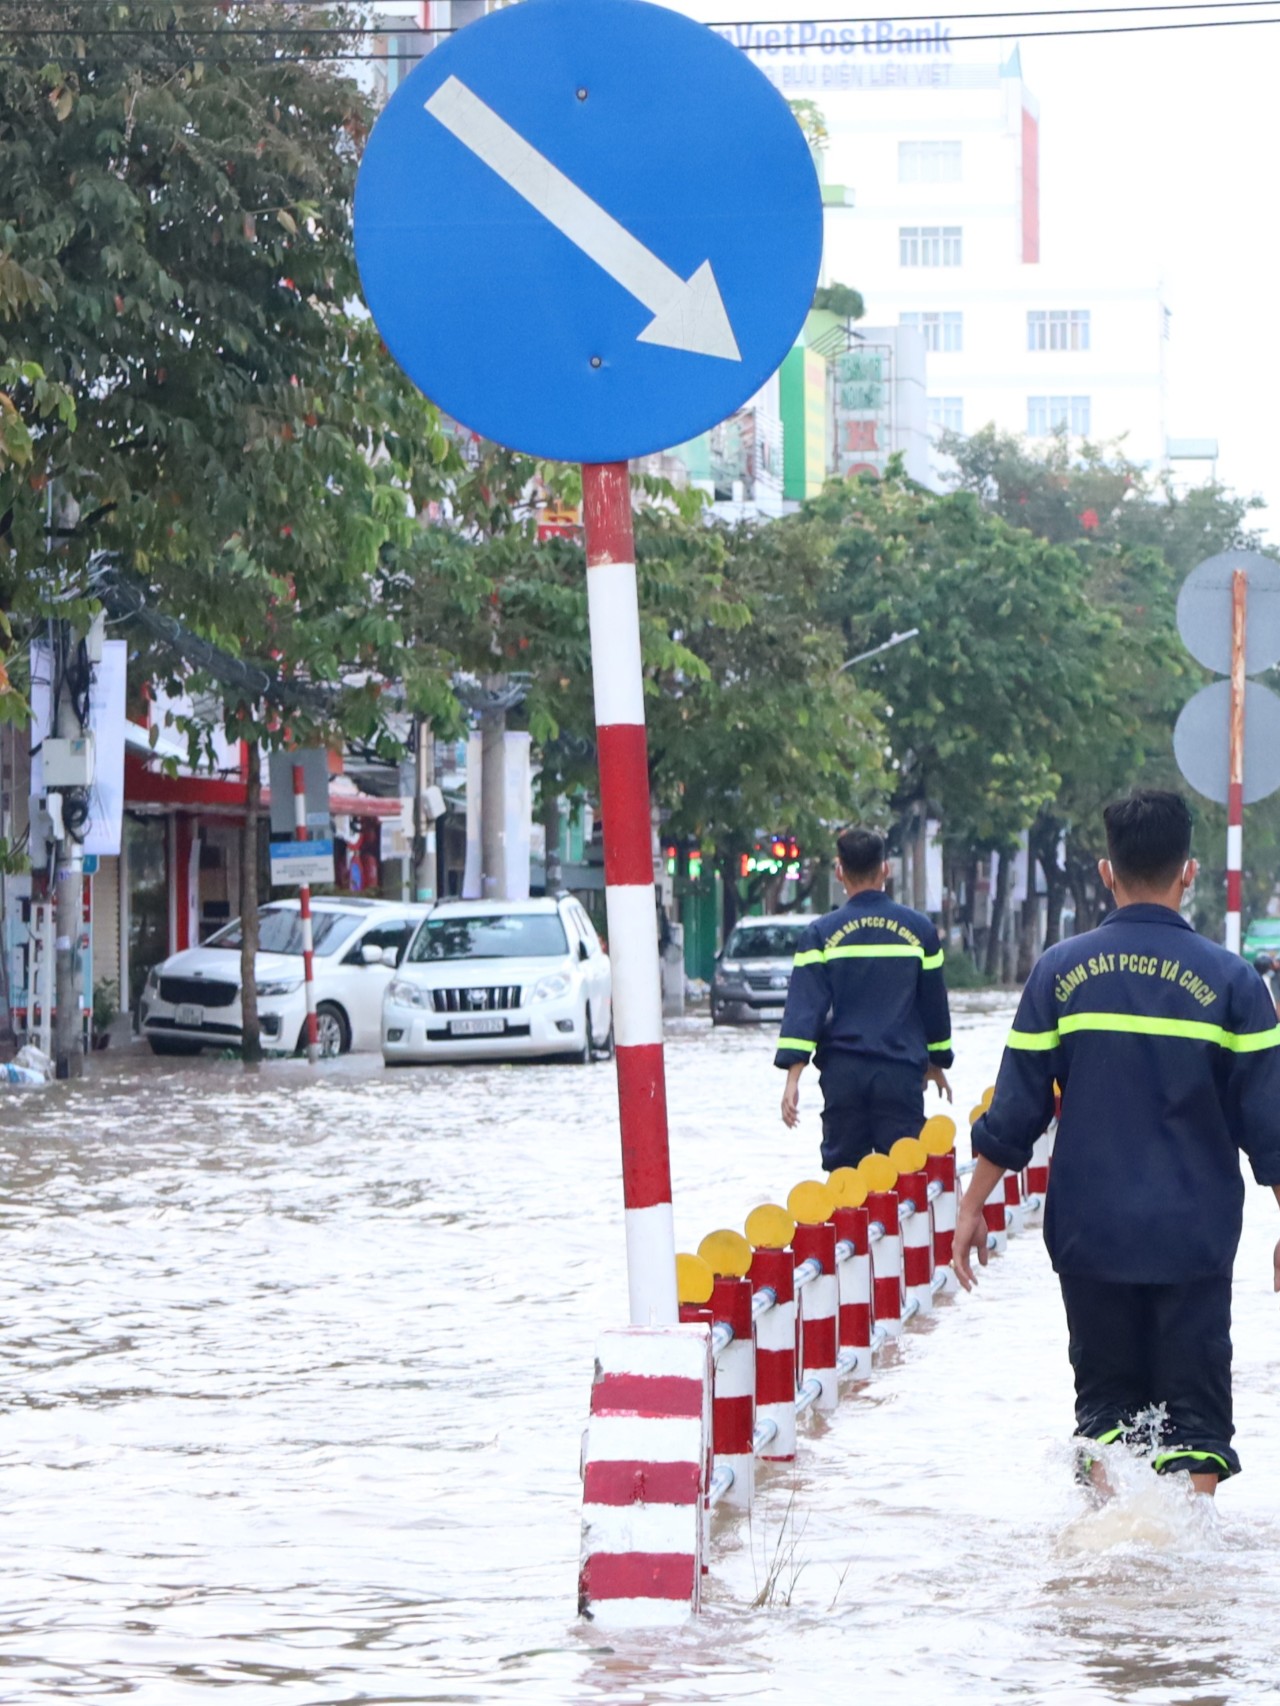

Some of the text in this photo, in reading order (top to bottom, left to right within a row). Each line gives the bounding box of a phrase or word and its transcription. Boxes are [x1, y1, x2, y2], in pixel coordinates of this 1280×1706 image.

[719, 21, 951, 56] nVietPostBank
[861, 916, 885, 929] PCCC
[1055, 952, 1218, 1007] CẢNH SÁT PCCC VÀ CNCH
